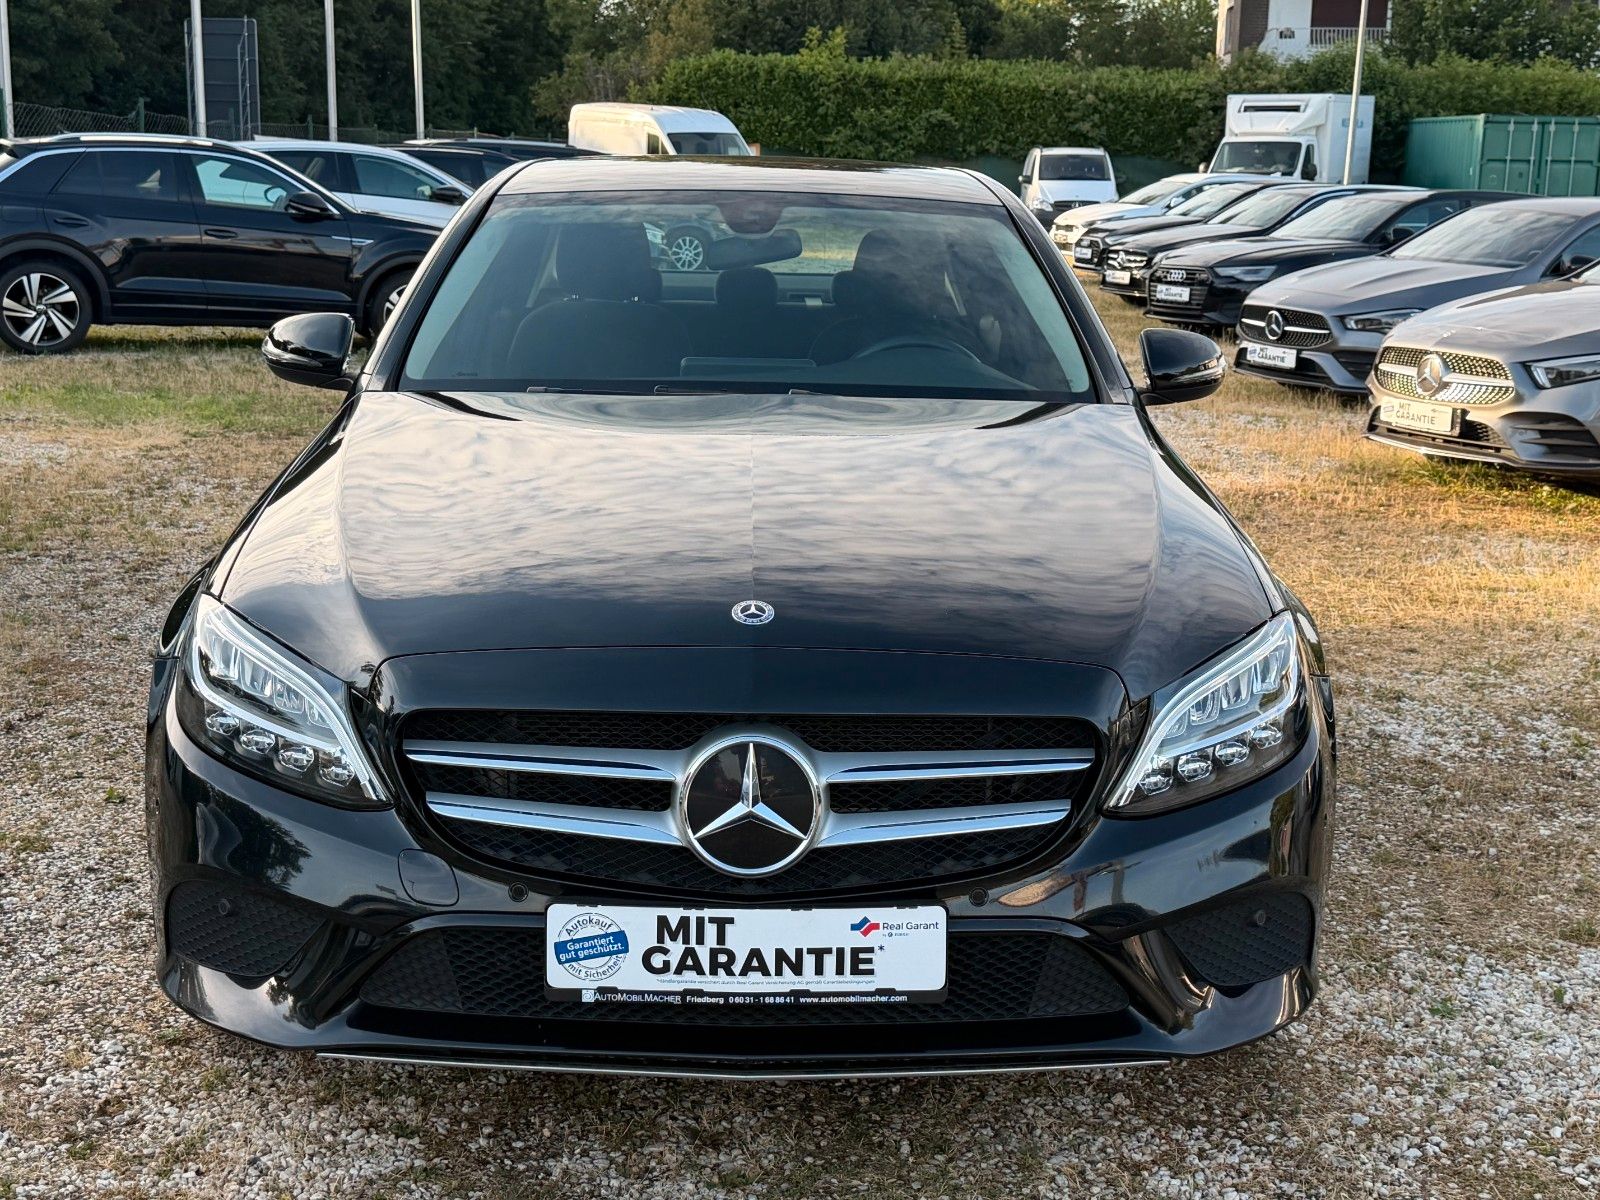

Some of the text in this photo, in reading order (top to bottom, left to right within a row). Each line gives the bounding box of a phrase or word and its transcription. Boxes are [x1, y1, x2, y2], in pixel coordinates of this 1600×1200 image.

[1399, 402, 1411, 410] MIT
[1395, 410, 1436, 425] GARANTIE
[565, 915, 614, 936] Autokauf
[656, 915, 735, 946] MIT
[882, 921, 939, 931] Real Garant
[566, 935, 615, 951] Garantiert
[559, 942, 625, 962] gut geschützt.
[567, 954, 623, 979] mit Sicherheit
[686, 995, 724, 1004] Friedberg
[799, 994, 908, 1003] www.automobilmacher.com
